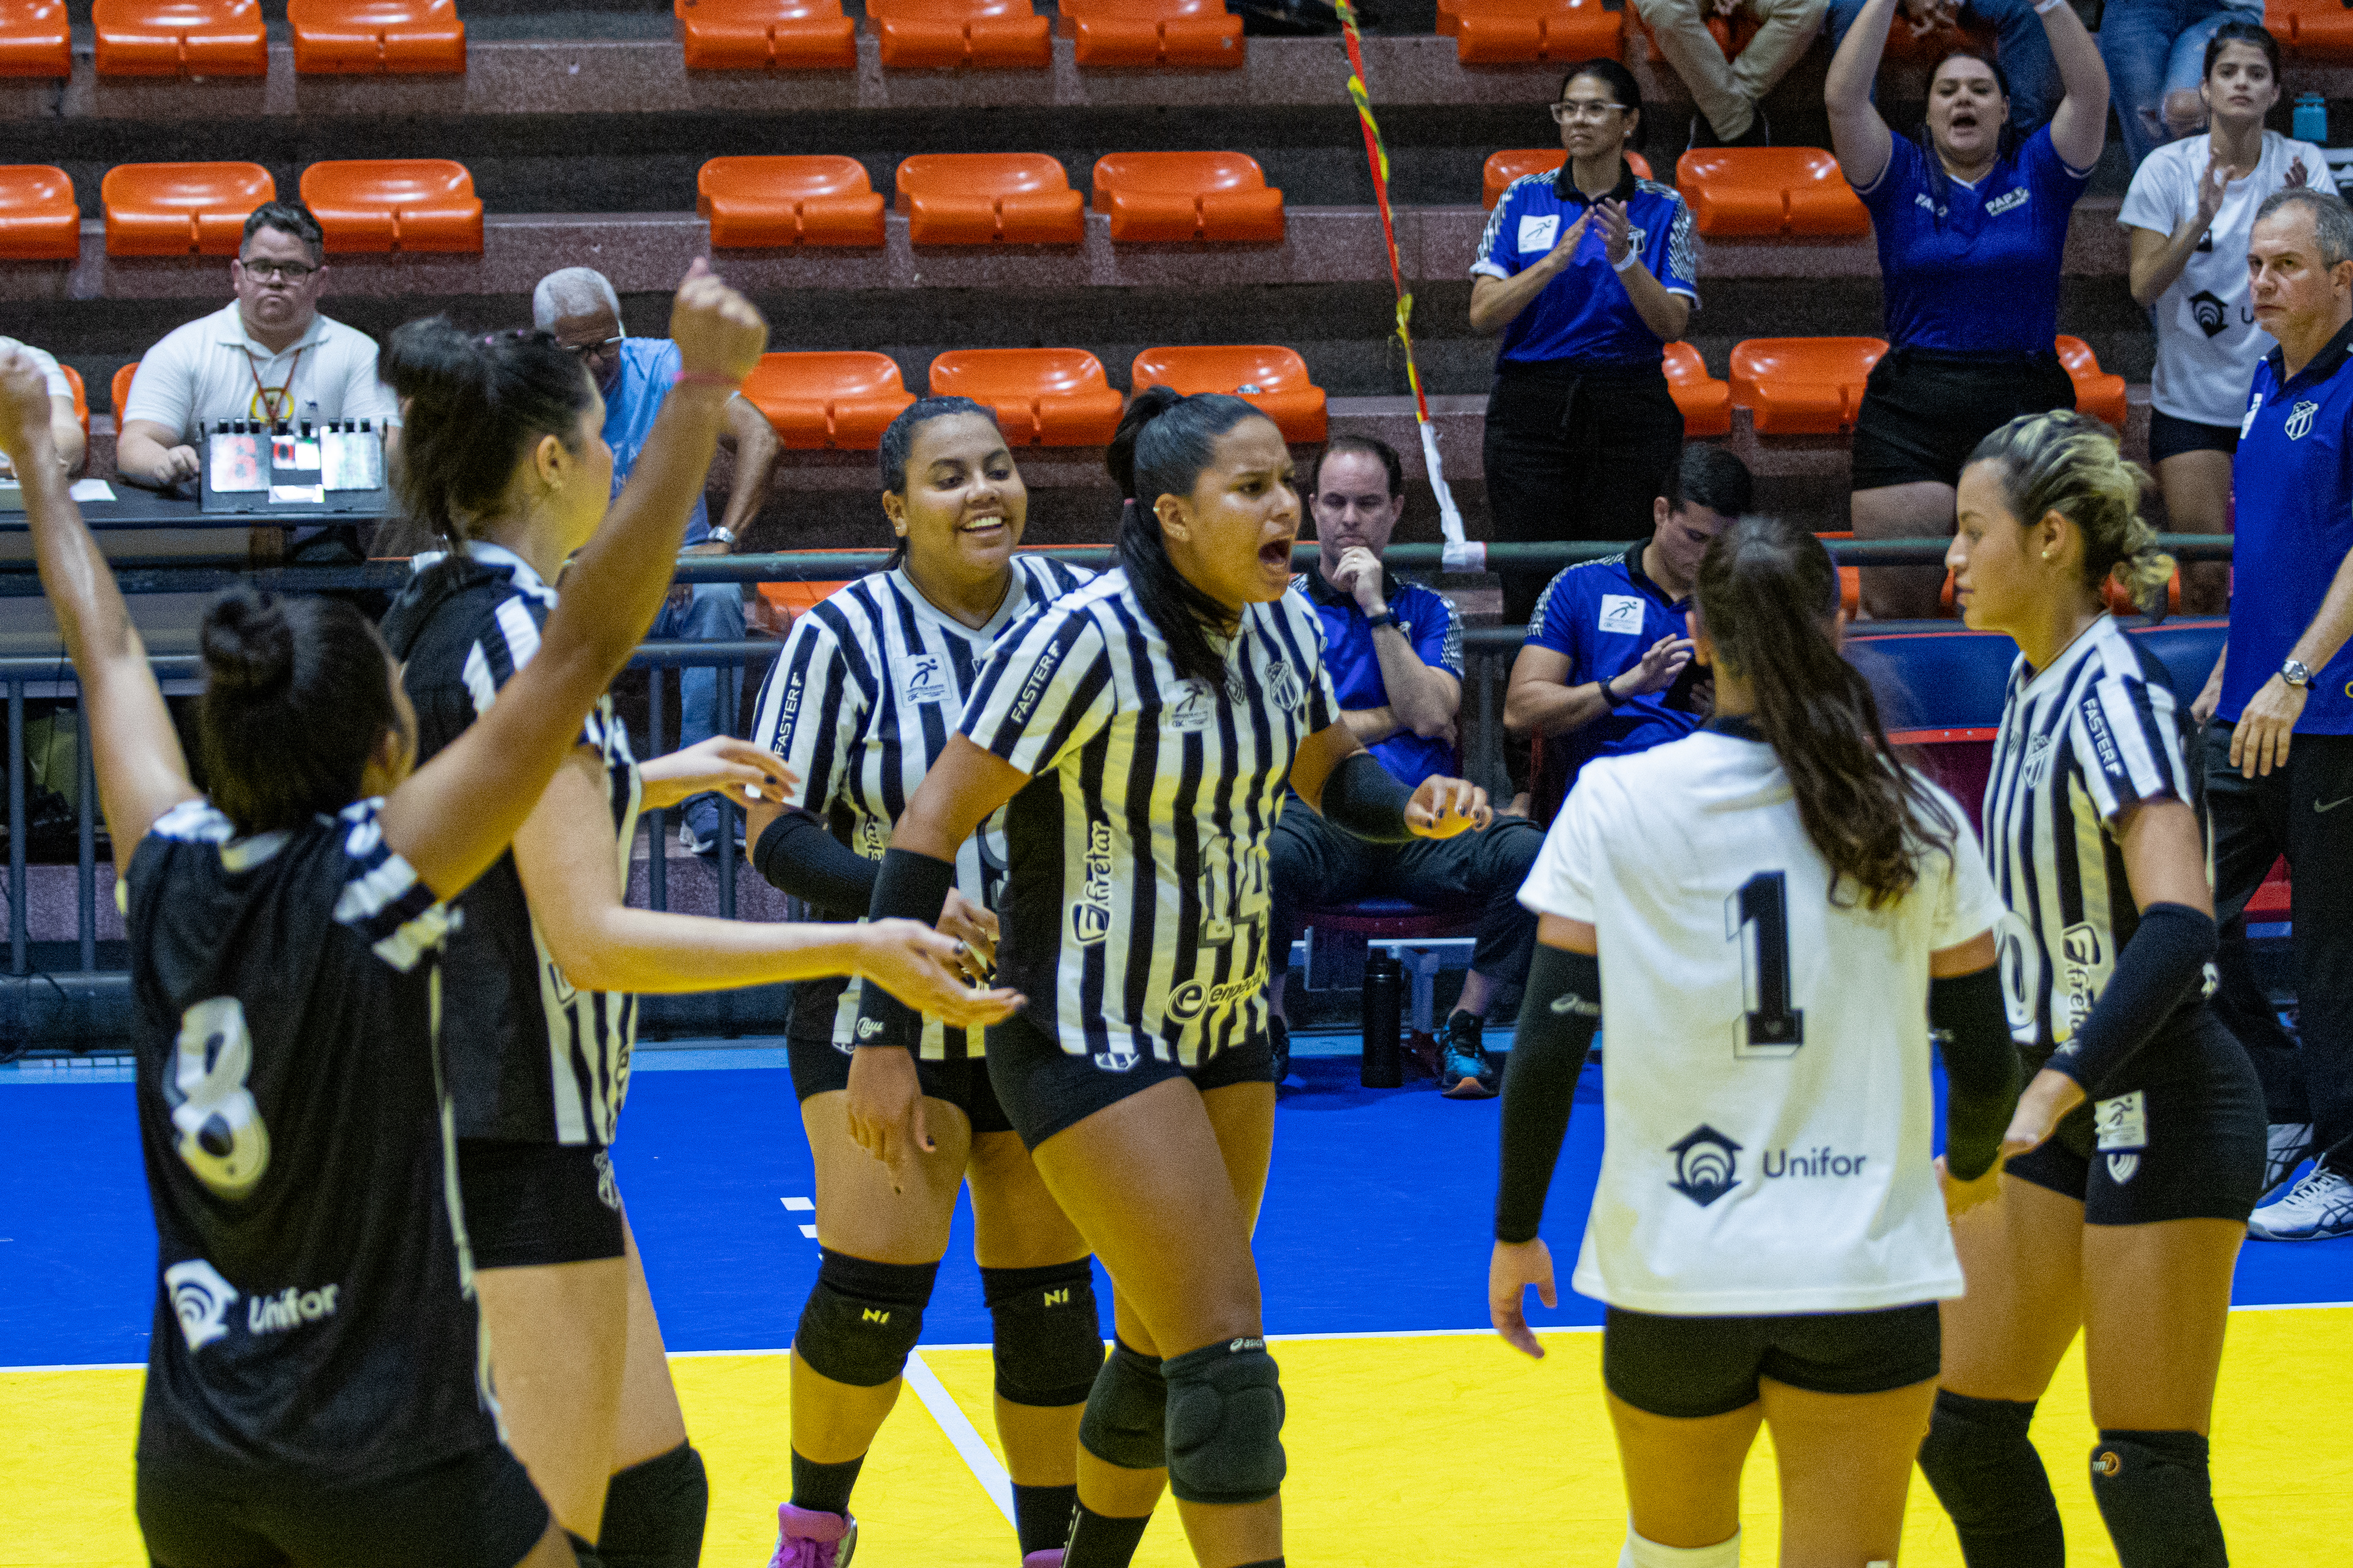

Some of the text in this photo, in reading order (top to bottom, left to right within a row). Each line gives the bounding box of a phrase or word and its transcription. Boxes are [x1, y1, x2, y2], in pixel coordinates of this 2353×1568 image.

[774, 688, 801, 756] FASTER
[1011, 655, 1054, 724] FASTER
[2083, 698, 2116, 763] FASTER
[1200, 835, 1270, 948] 14
[1727, 870, 1804, 1057] 1
[170, 996, 272, 1197] 8
[1763, 1146, 1866, 1177] Unifor
[249, 1283, 339, 1334] Unifor
[862, 1308, 889, 1324] N1
[1044, 1288, 1068, 1306] N1
[1244, 1339, 1263, 1348] asics
